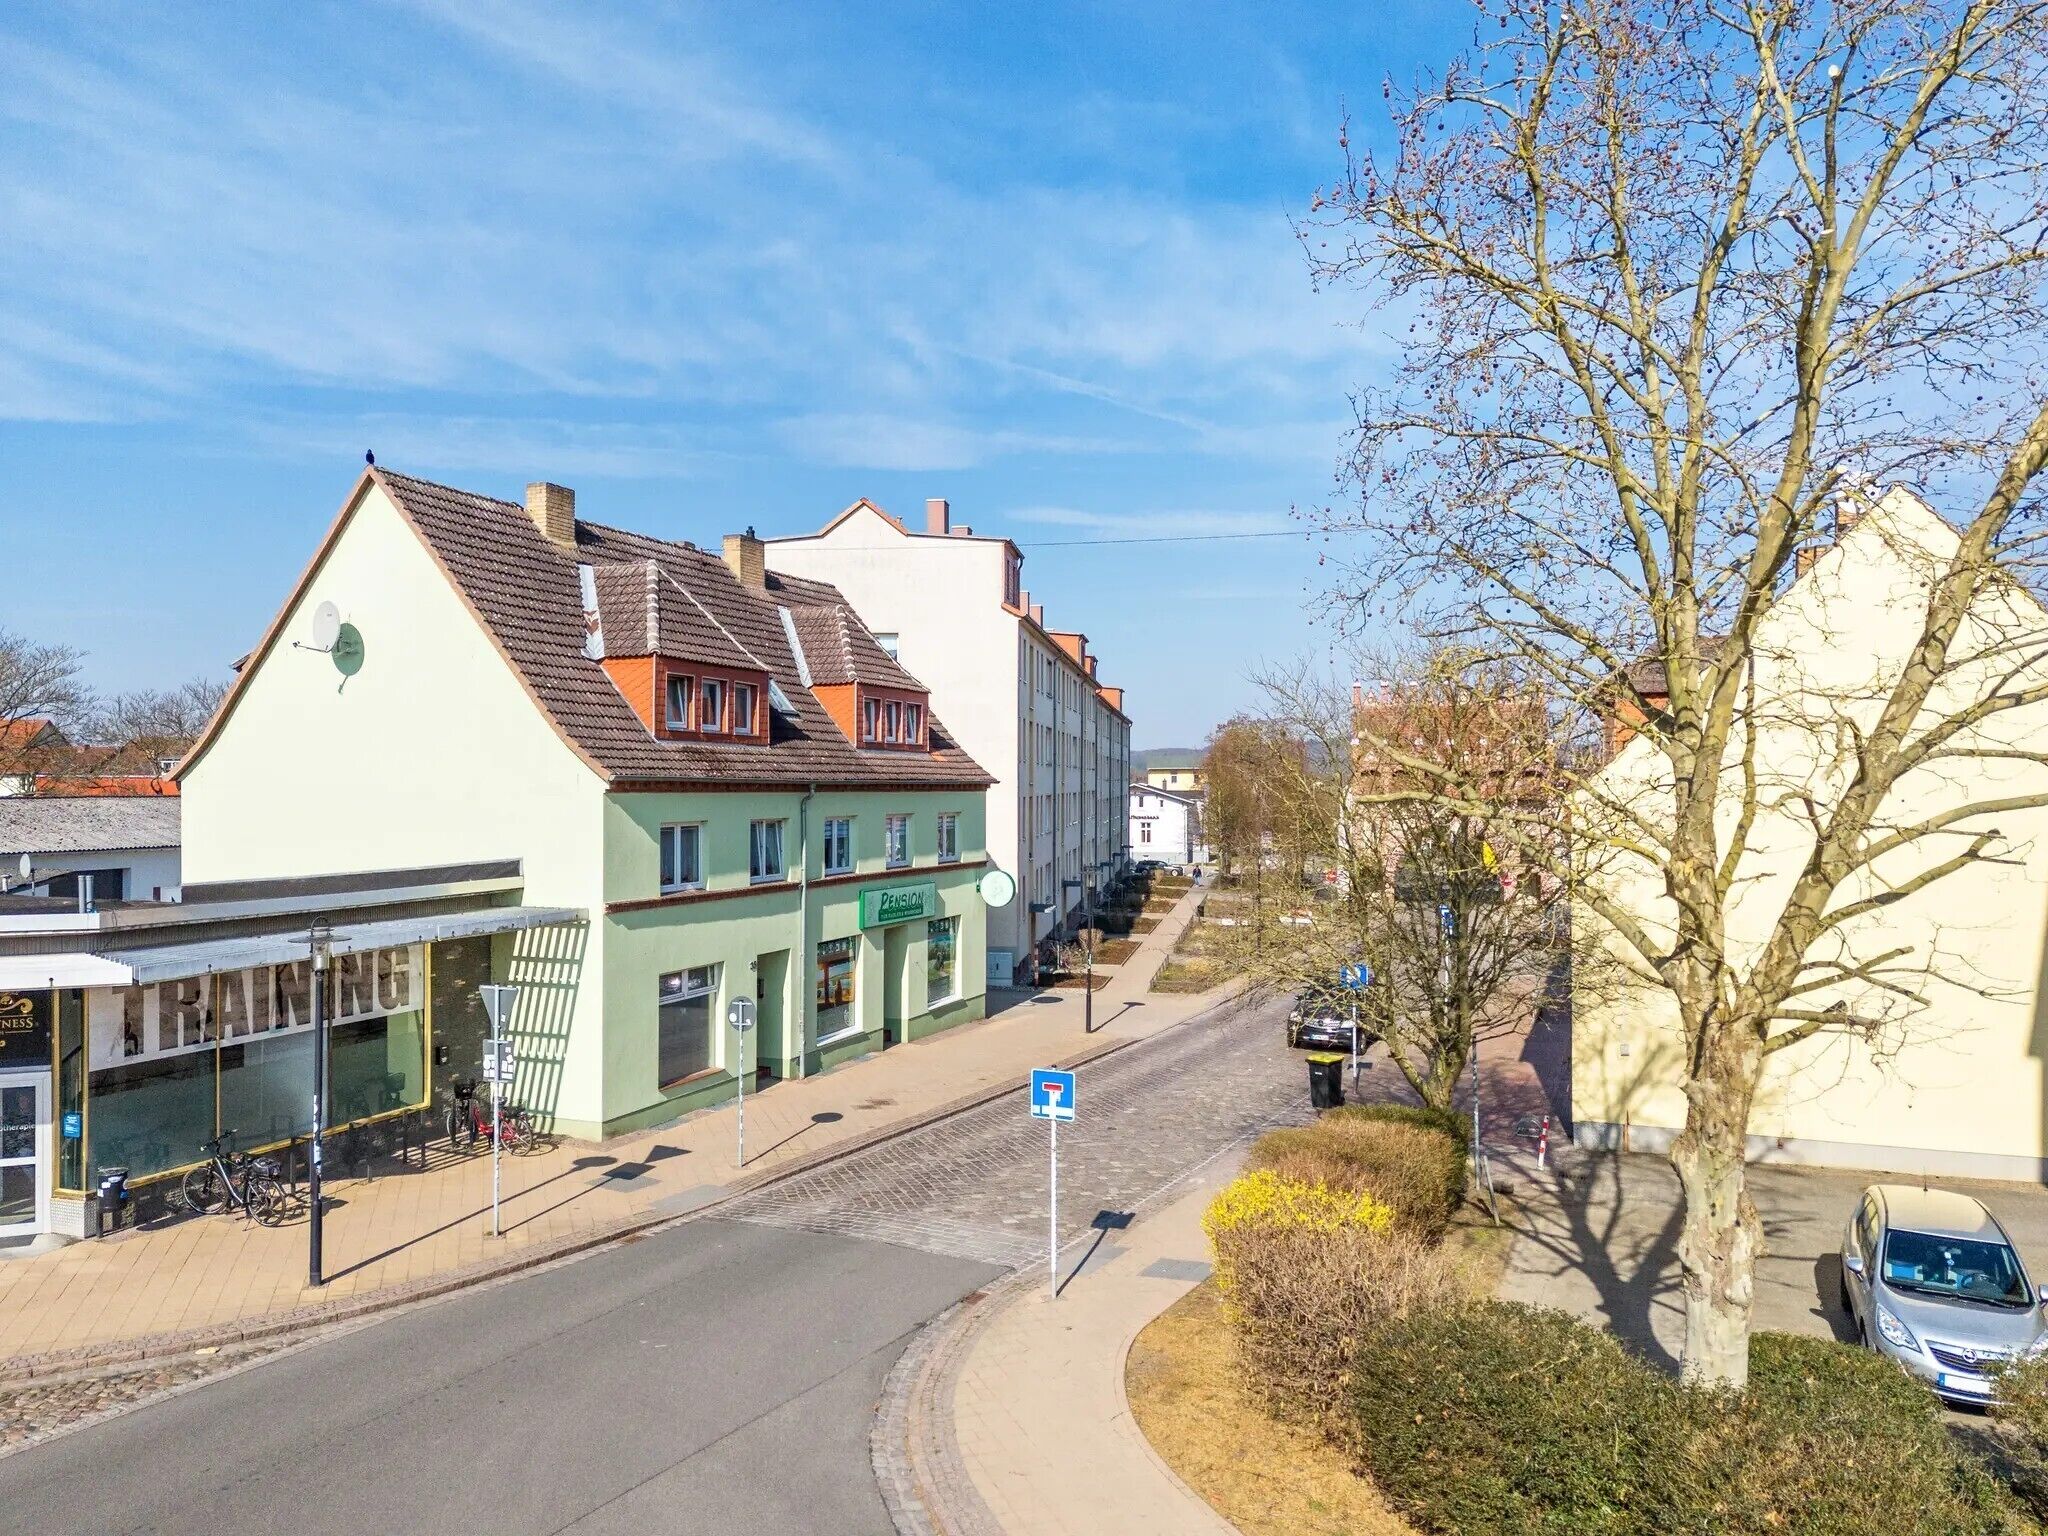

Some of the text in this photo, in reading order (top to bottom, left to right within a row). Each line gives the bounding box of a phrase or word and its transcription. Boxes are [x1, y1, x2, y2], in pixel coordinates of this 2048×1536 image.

[881, 891, 924, 910] PENSION
[112, 944, 410, 1057] TRAINING
[0, 1017, 34, 1029] NESS
